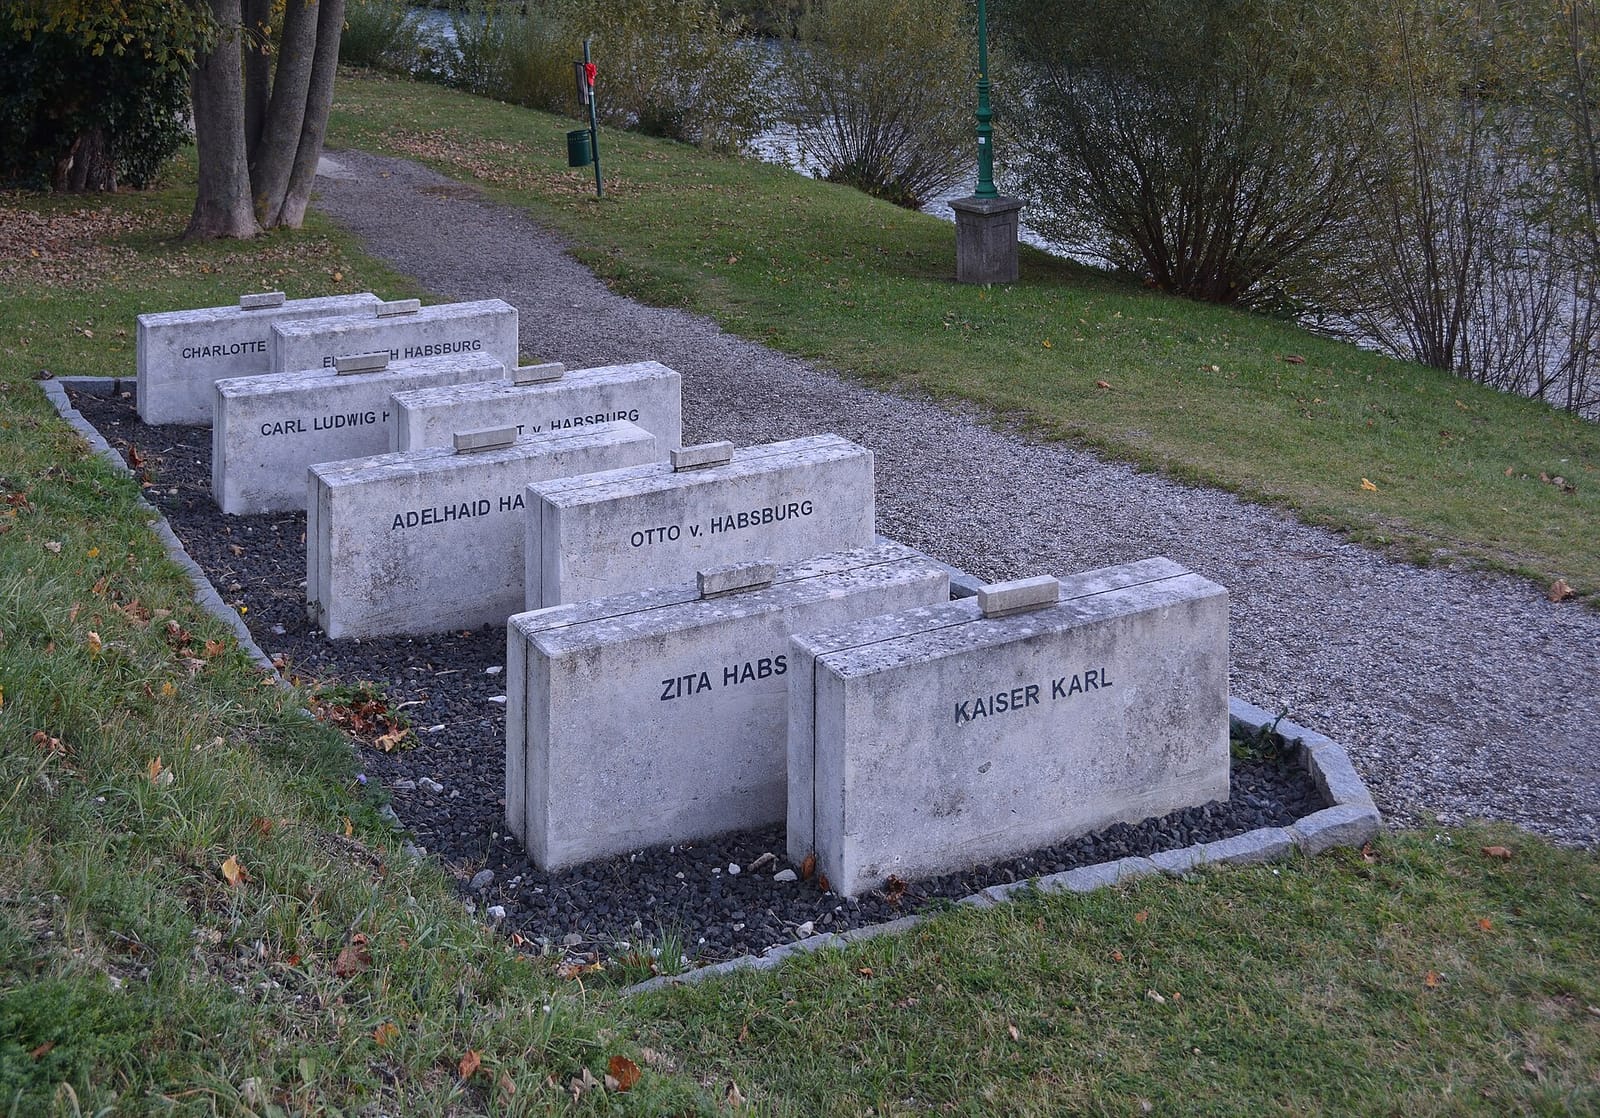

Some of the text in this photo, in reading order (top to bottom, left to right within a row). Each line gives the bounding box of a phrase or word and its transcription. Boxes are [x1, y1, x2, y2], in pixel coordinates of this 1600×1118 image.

[182, 340, 267, 359] CHARLOTTE
[405, 339, 481, 359] HABSBURG
[261, 419, 307, 436] CARL
[314, 411, 376, 431] LUDWIG
[551, 409, 639, 431] HABSBURG
[392, 498, 491, 531] ADELHAID
[630, 500, 813, 548] OTTO v. HABSBURG
[660, 671, 713, 701] ZITA
[954, 667, 1113, 723] KAISER KARL
